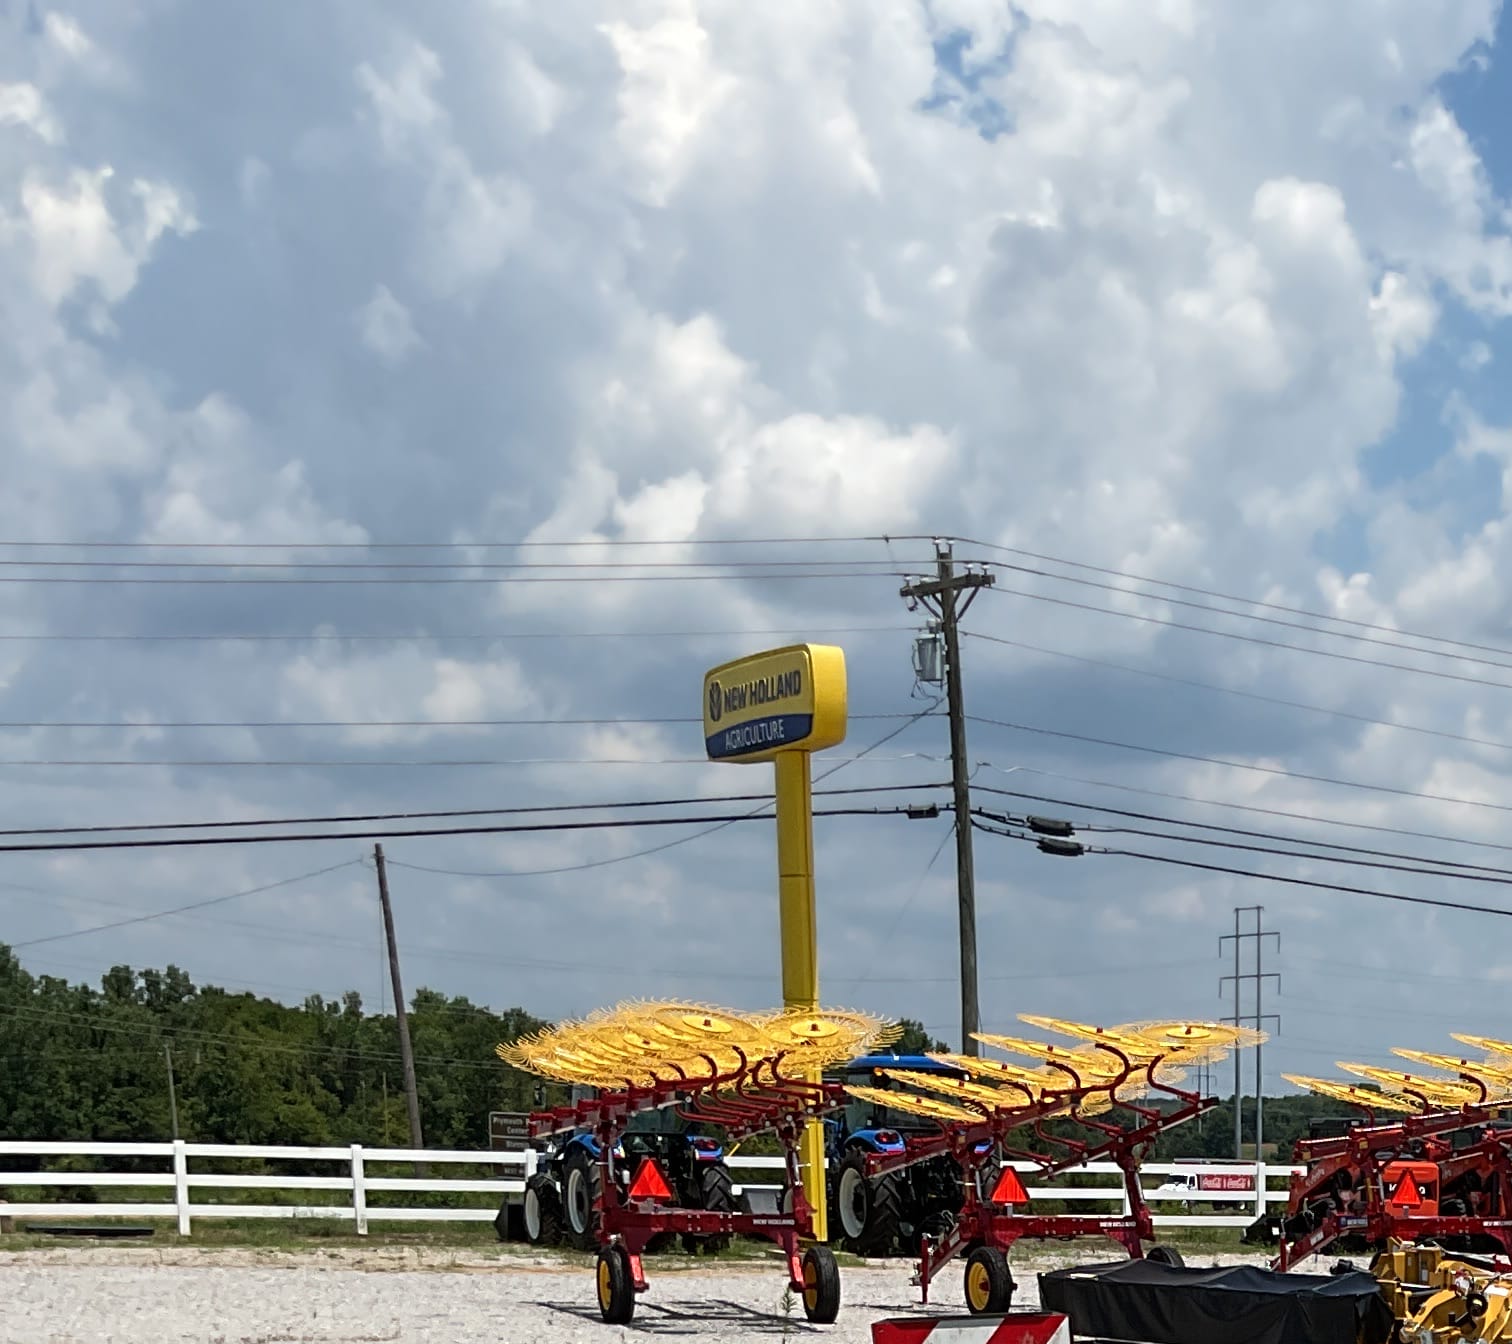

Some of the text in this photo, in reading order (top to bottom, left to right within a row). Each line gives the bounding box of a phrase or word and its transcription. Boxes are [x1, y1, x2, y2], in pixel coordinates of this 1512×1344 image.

[724, 669, 801, 713] NEW HOLLAND
[725, 719, 785, 750] AGRICULTURE
